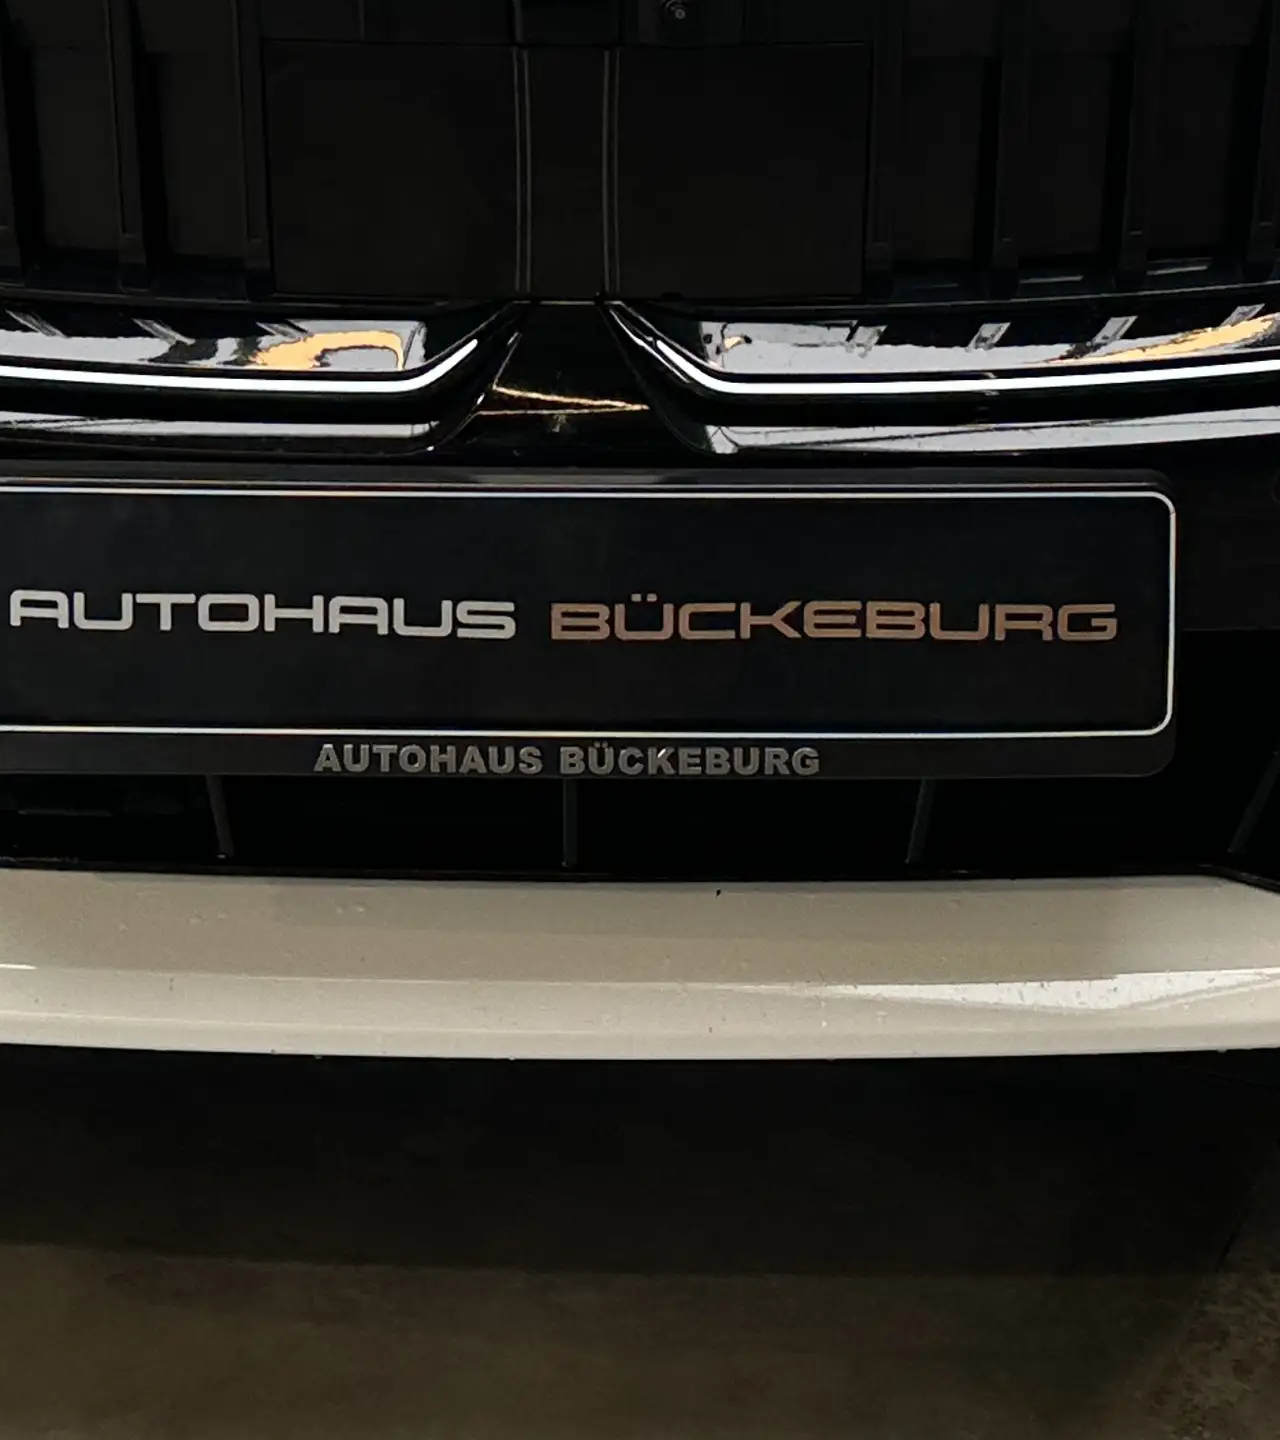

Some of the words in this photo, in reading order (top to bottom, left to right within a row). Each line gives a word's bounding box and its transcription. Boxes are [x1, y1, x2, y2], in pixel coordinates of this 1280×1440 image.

[10, 589, 516, 641] AUTOHAUS
[550, 592, 1118, 642] BÜCKEBURG
[314, 742, 543, 774] AUTOHAUS
[559, 741, 821, 776] BÜCKEBURG
